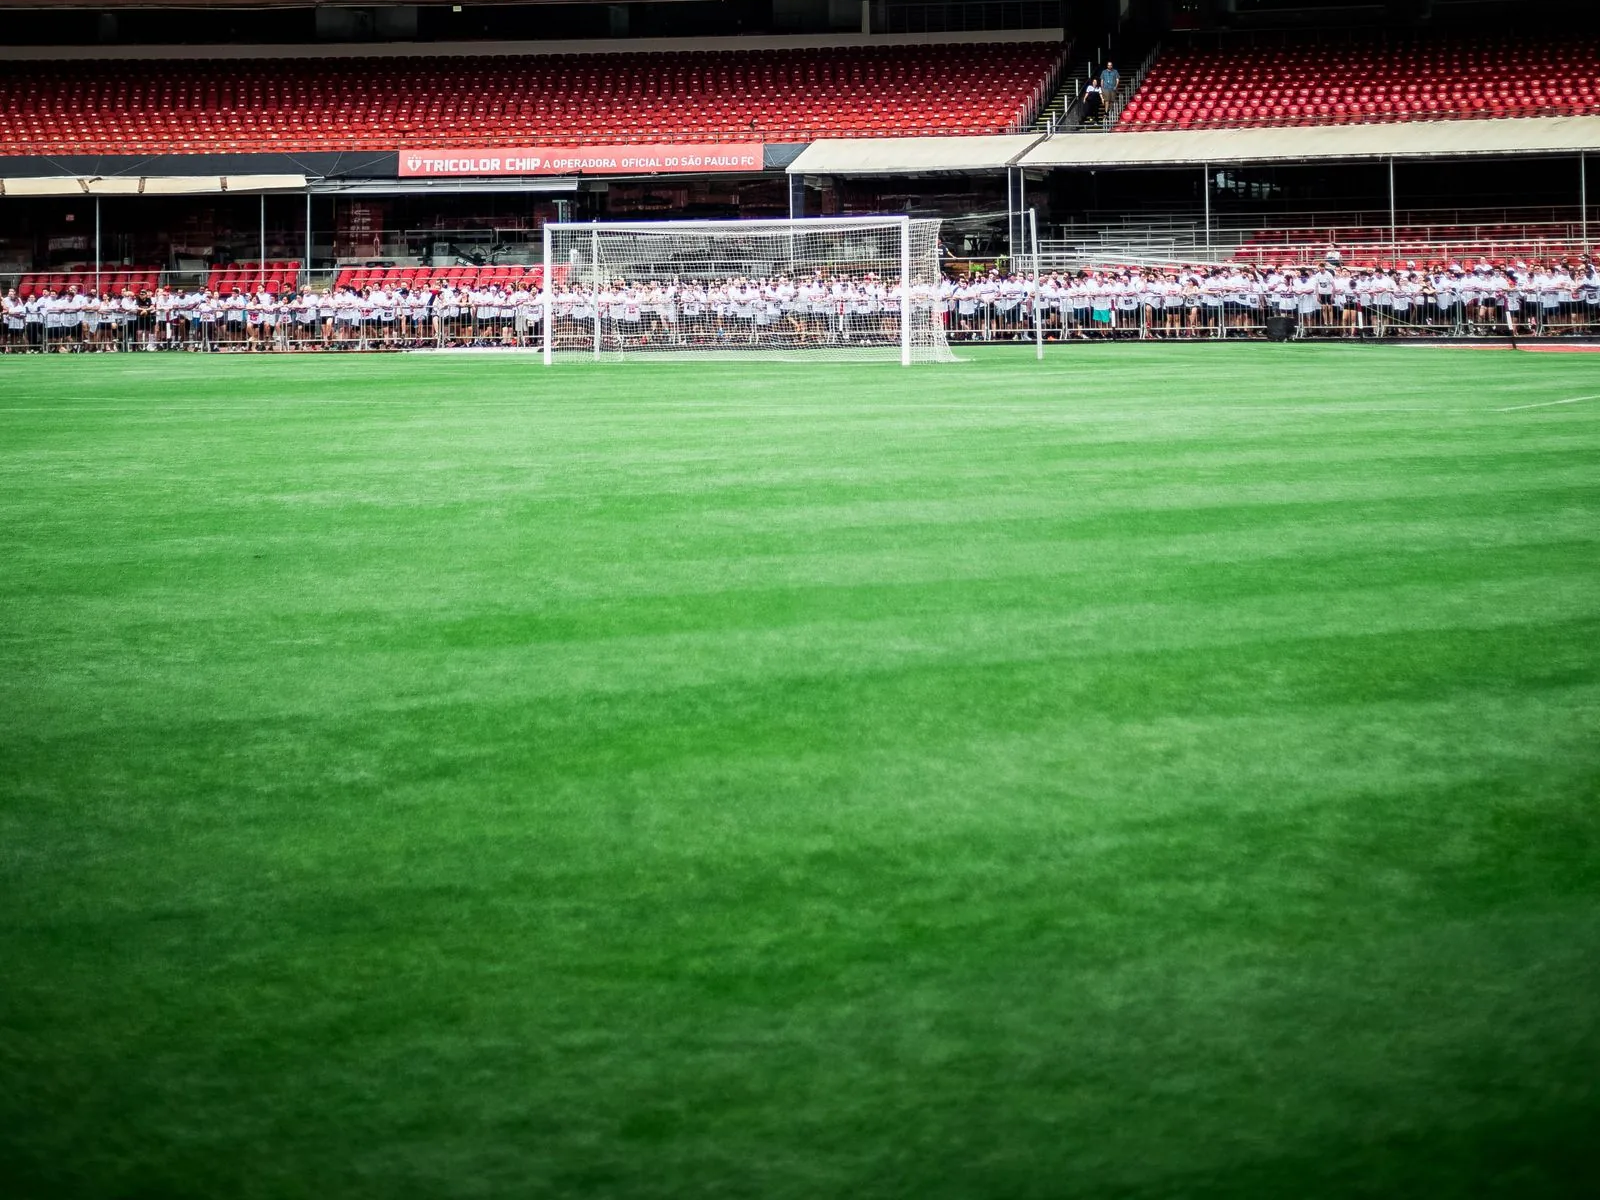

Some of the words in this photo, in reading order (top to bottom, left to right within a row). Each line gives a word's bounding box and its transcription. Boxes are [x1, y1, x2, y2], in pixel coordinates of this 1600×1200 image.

[423, 158, 501, 172] TRICOLOR
[505, 157, 541, 171] CHIP
[542, 161, 551, 169] A
[553, 158, 617, 169] OPERADORA
[621, 157, 662, 168] OFICIAL
[664, 156, 679, 167] DO
[681, 154, 701, 166] SÃO
[704, 155, 739, 166] PAULO
[741, 155, 754, 165] FC
